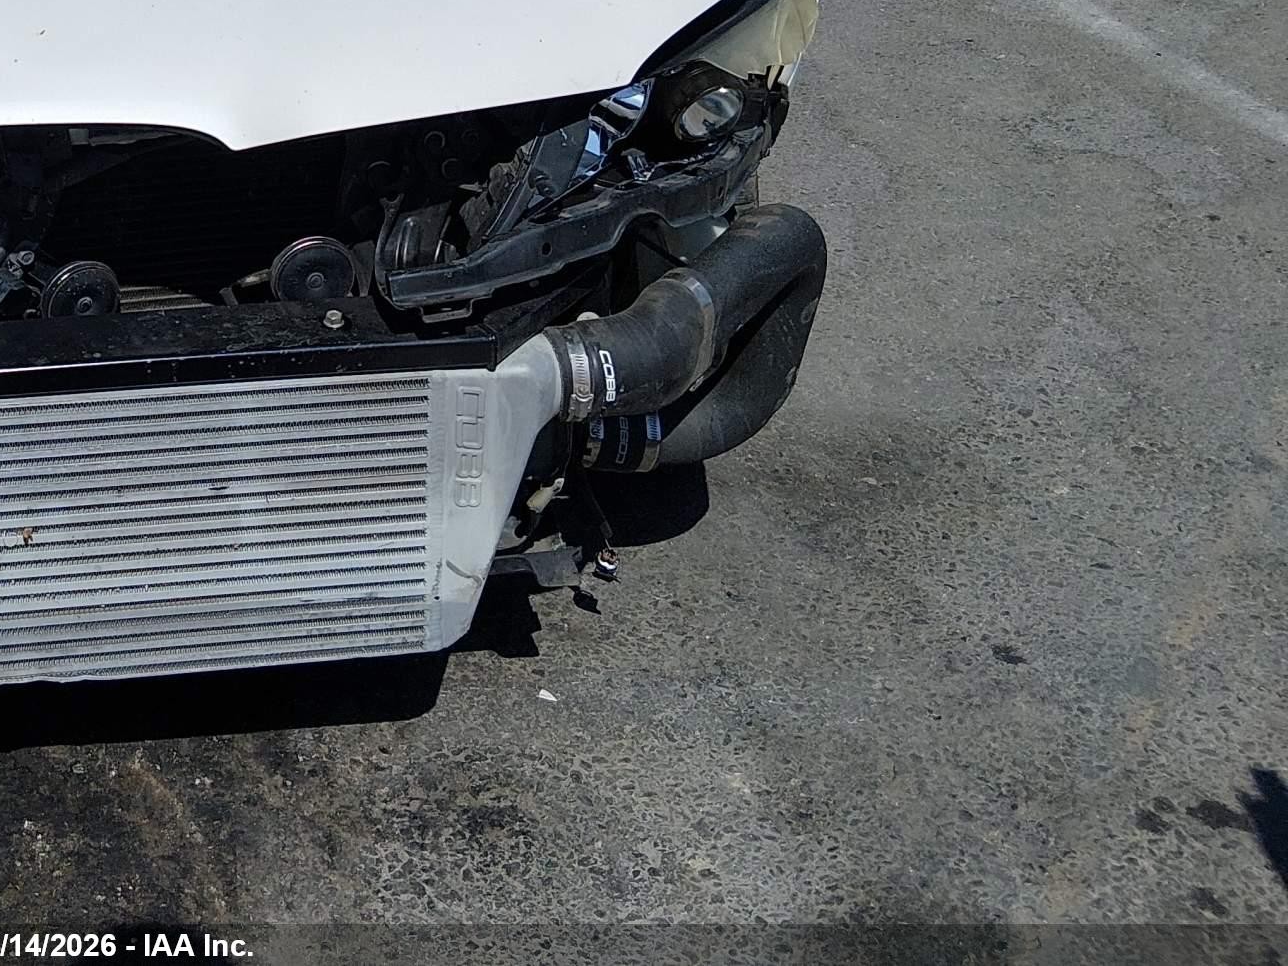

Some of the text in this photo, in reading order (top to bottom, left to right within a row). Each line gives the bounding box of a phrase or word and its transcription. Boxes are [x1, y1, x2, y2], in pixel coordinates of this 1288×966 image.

[598, 350, 616, 402] COBB
[455, 387, 486, 508] COBB
[616, 416, 629, 464] COBB
